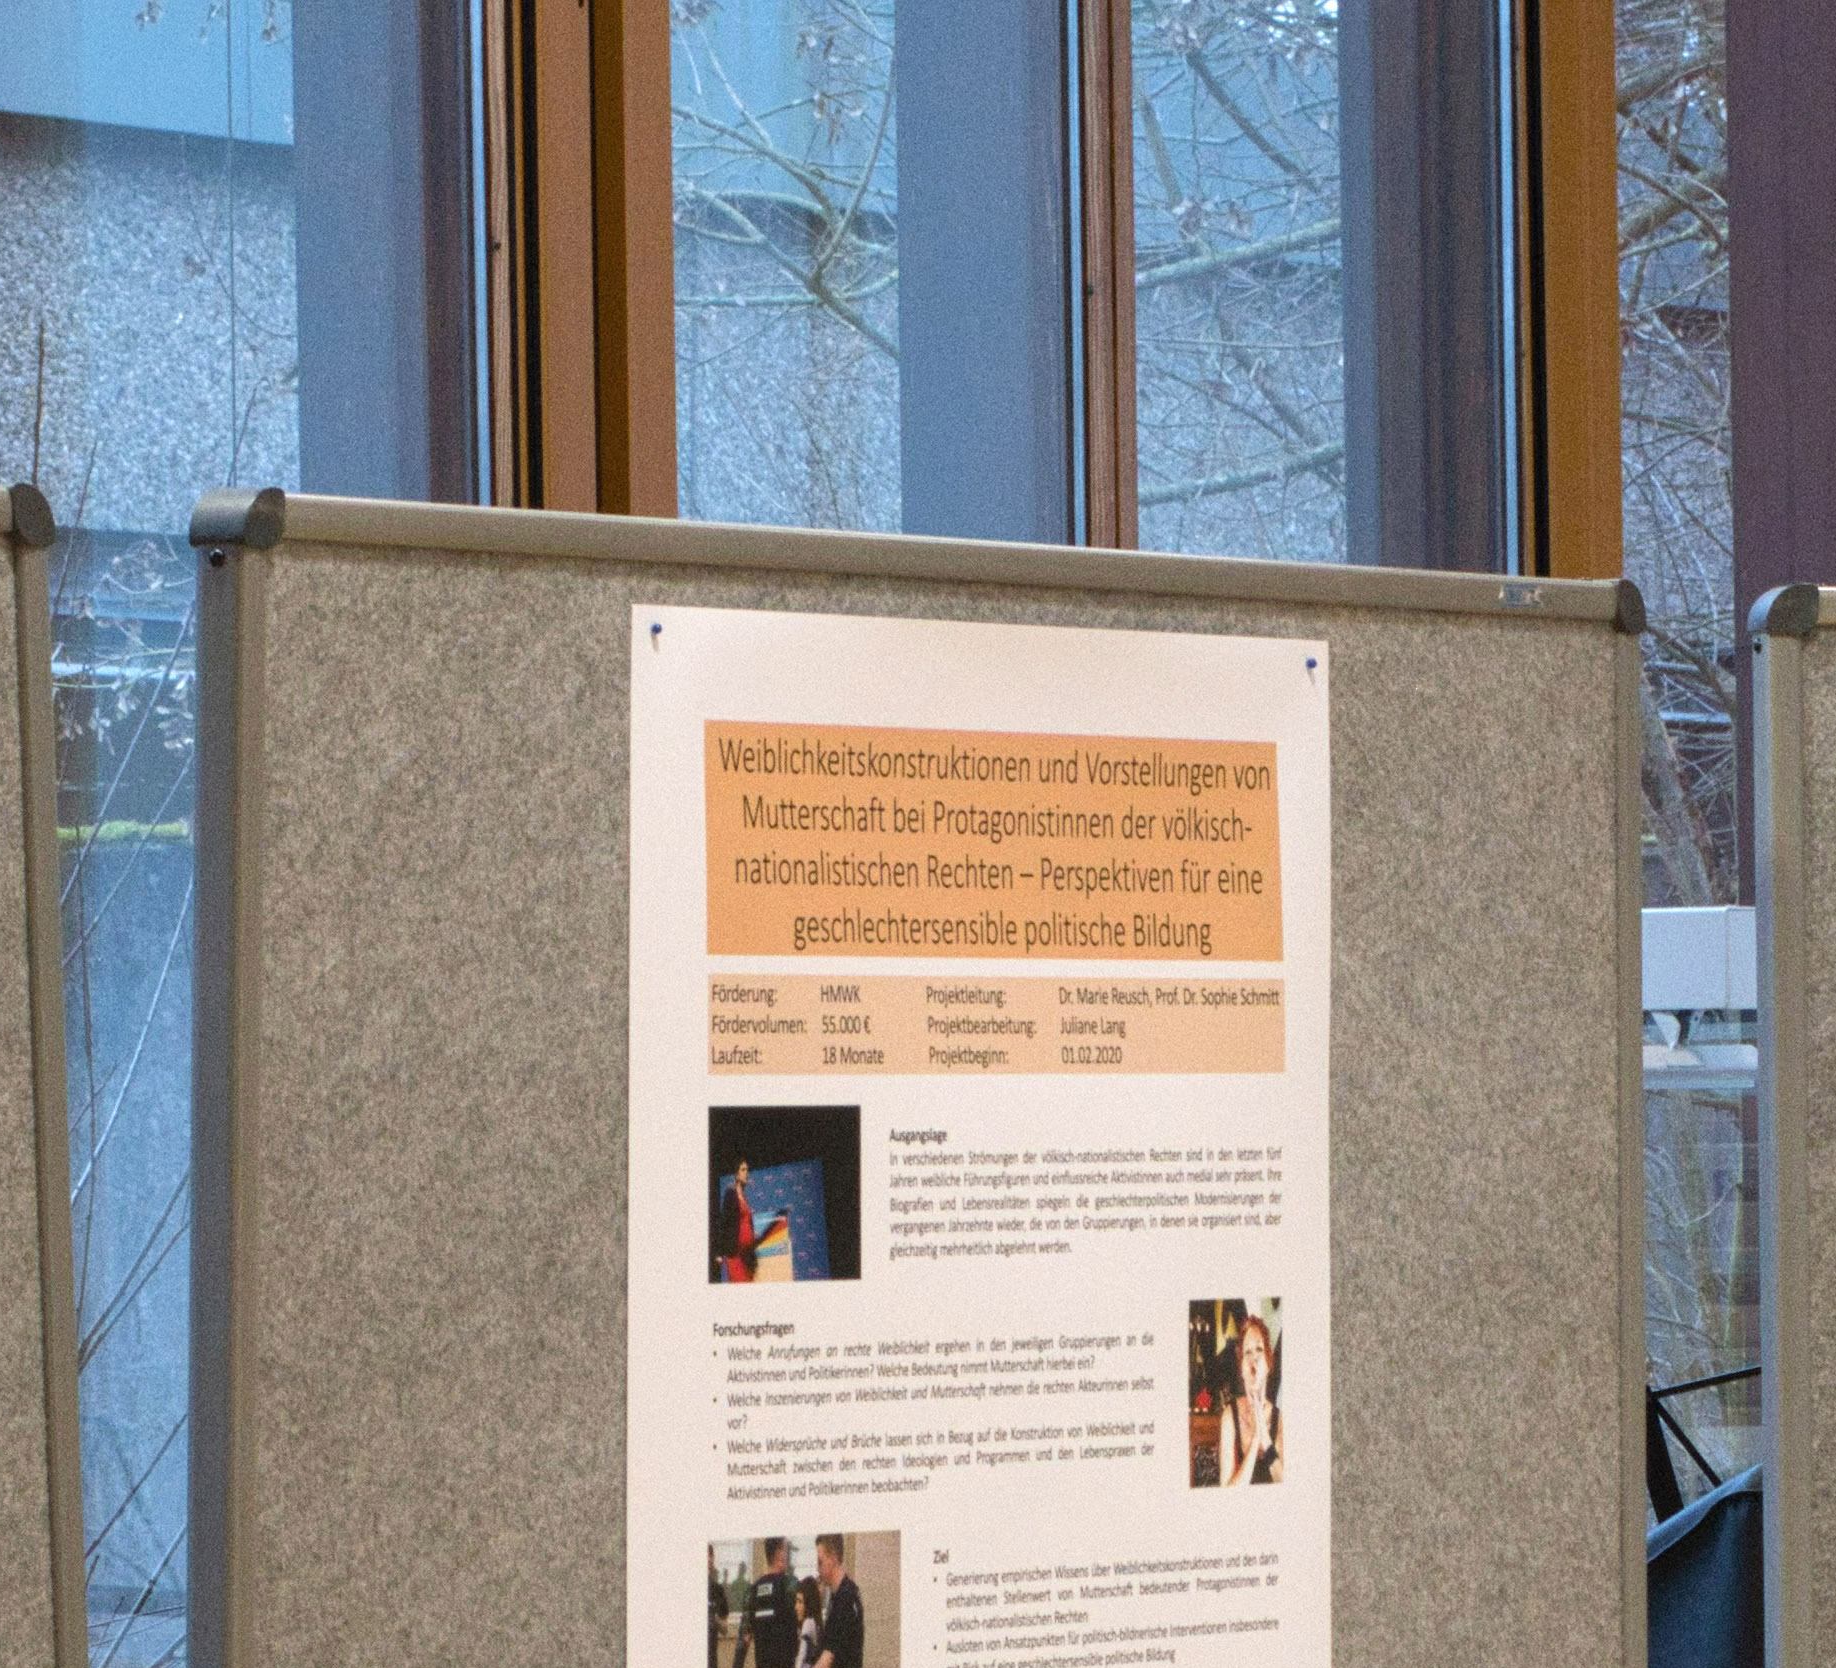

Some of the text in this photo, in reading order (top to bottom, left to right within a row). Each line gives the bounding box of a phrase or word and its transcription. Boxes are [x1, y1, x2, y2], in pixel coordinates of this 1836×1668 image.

[718, 737, 1271, 791] Weiblichkeitskonstruktionen und Vorstellungen von
[742, 794, 1253, 843] Mutterschaft bei Protagonistinnen der völkisch-
[735, 852, 919, 889] nationalistischen
[927, 854, 1014, 891] Rechten
[1040, 856, 1174, 897] Perspektiven
[1180, 858, 1211, 894] für
[1217, 861, 1263, 896] eine
[793, 908, 1213, 957] geschlechtersensible politische Bildung
[711, 983, 778, 1009] Förderung:
[820, 984, 861, 1003] HMWK
[925, 985, 1007, 1010] Projektleitung:
[711, 1014, 807, 1035] Fördervolumen:
[821, 1014, 871, 1035] 55.000 €
[927, 1015, 1037, 1040] Projektbearbeitung:
[1060, 1016, 1127, 1040] Juliane Lang
[711, 1044, 762, 1066] Laufzeit:
[822, 1045, 885, 1065] 18 Monate
[928, 1045, 1009, 1069] Projektbeginn:
[1061, 1045, 1123, 1065] 01.02.2020
[889, 1128, 948, 1146] Ausgangslage
[712, 1320, 795, 1339] Forschungsfragen
